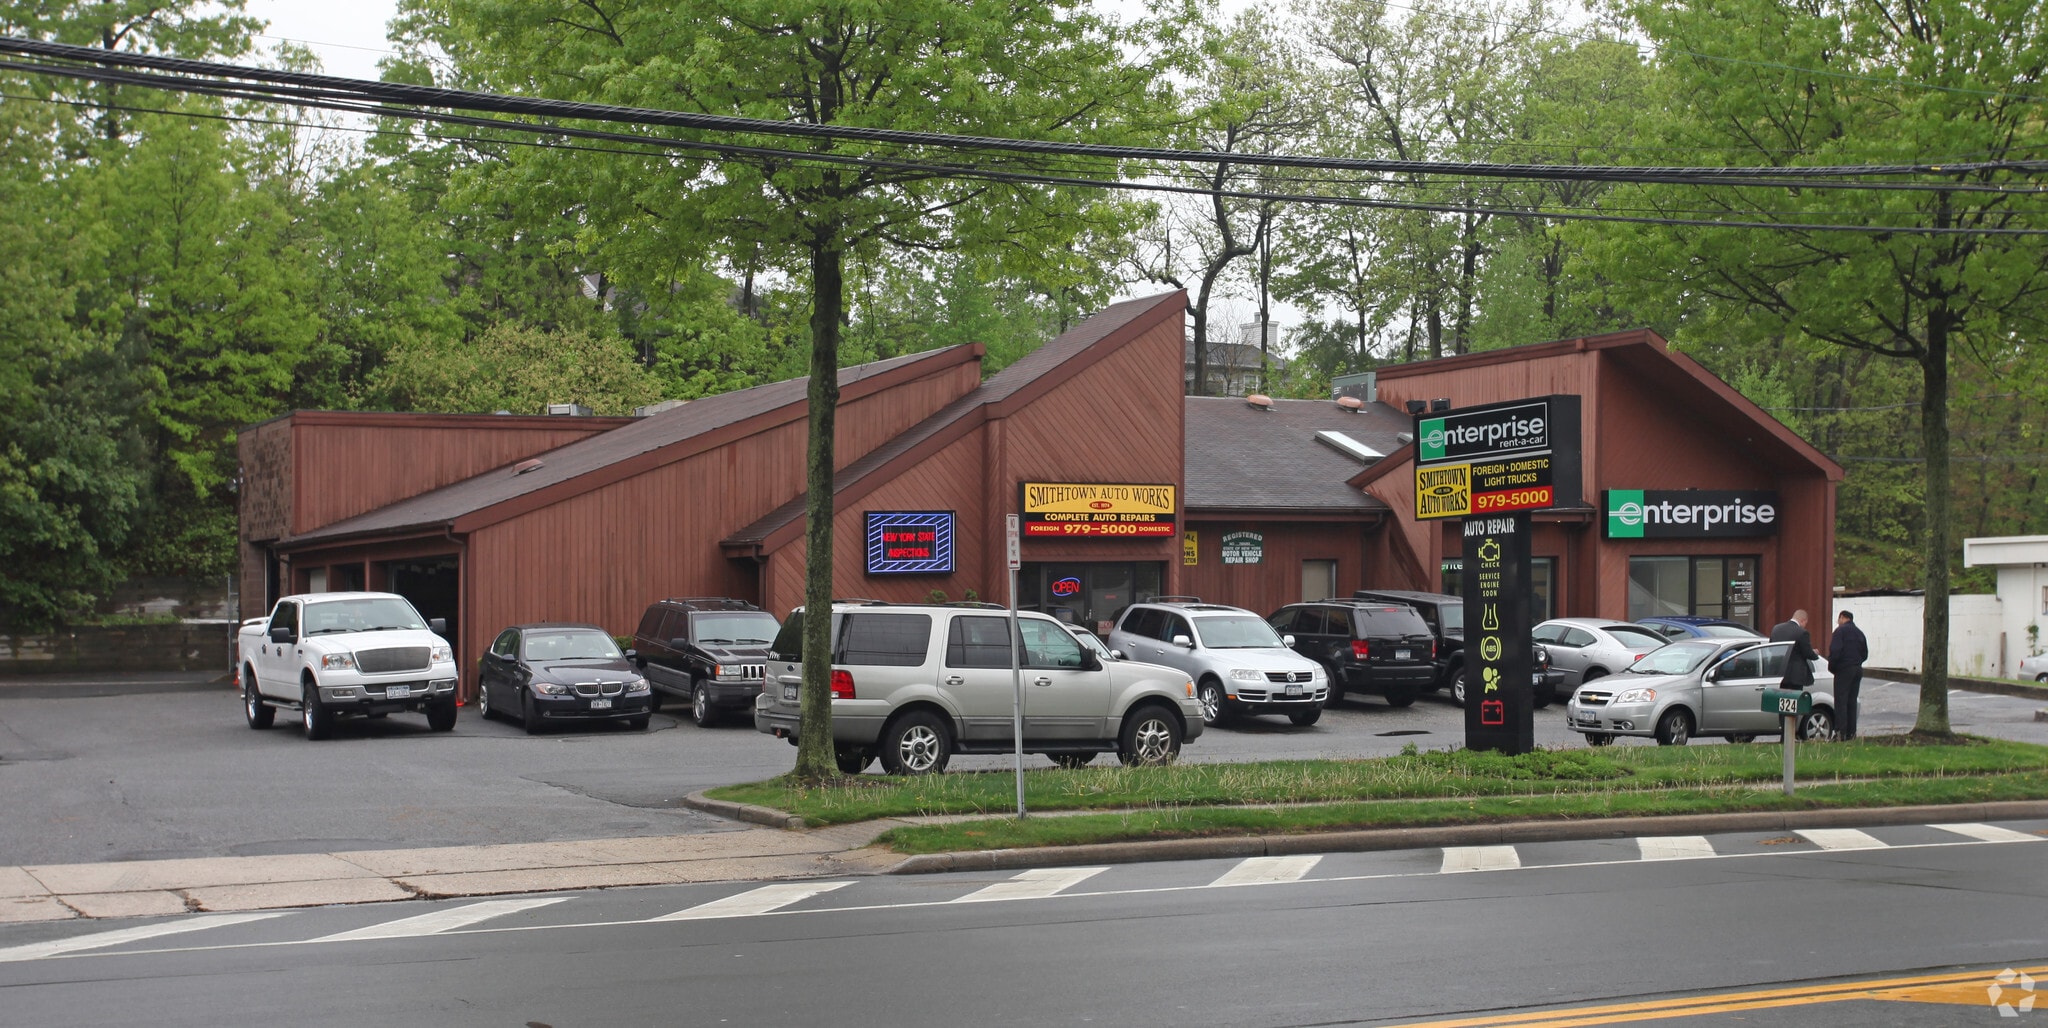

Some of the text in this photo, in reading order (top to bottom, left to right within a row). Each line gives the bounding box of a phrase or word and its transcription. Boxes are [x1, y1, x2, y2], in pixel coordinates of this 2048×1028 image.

[1421, 415, 1544, 449] enterprise
[1499, 435, 1544, 448] rent-a-car
[1473, 459, 1549, 476] FOREIGN DOMESTIC
[1420, 468, 1467, 491] SMITHTOWN
[1484, 473, 1537, 487] LIGHT TRUCKS
[1030, 486, 1170, 510] SMITHTOWN AUTO WORKS
[1420, 488, 1467, 514] AUTO WORKS
[1478, 490, 1549, 508] 979-5000
[1045, 513, 1089, 521] COMPLETE
[1120, 514, 1156, 522] REPAIRS
[1609, 498, 1775, 531] enterprise
[1464, 518, 1515, 537] AUTO REPAIR
[883, 531, 935, 542] NEW YORK STATE
[1222, 531, 1263, 542] REGISTERED
[888, 547, 930, 558] INSPECTIONS
[1052, 581, 1080, 593] OPEN
[1780, 698, 1796, 712] 324
